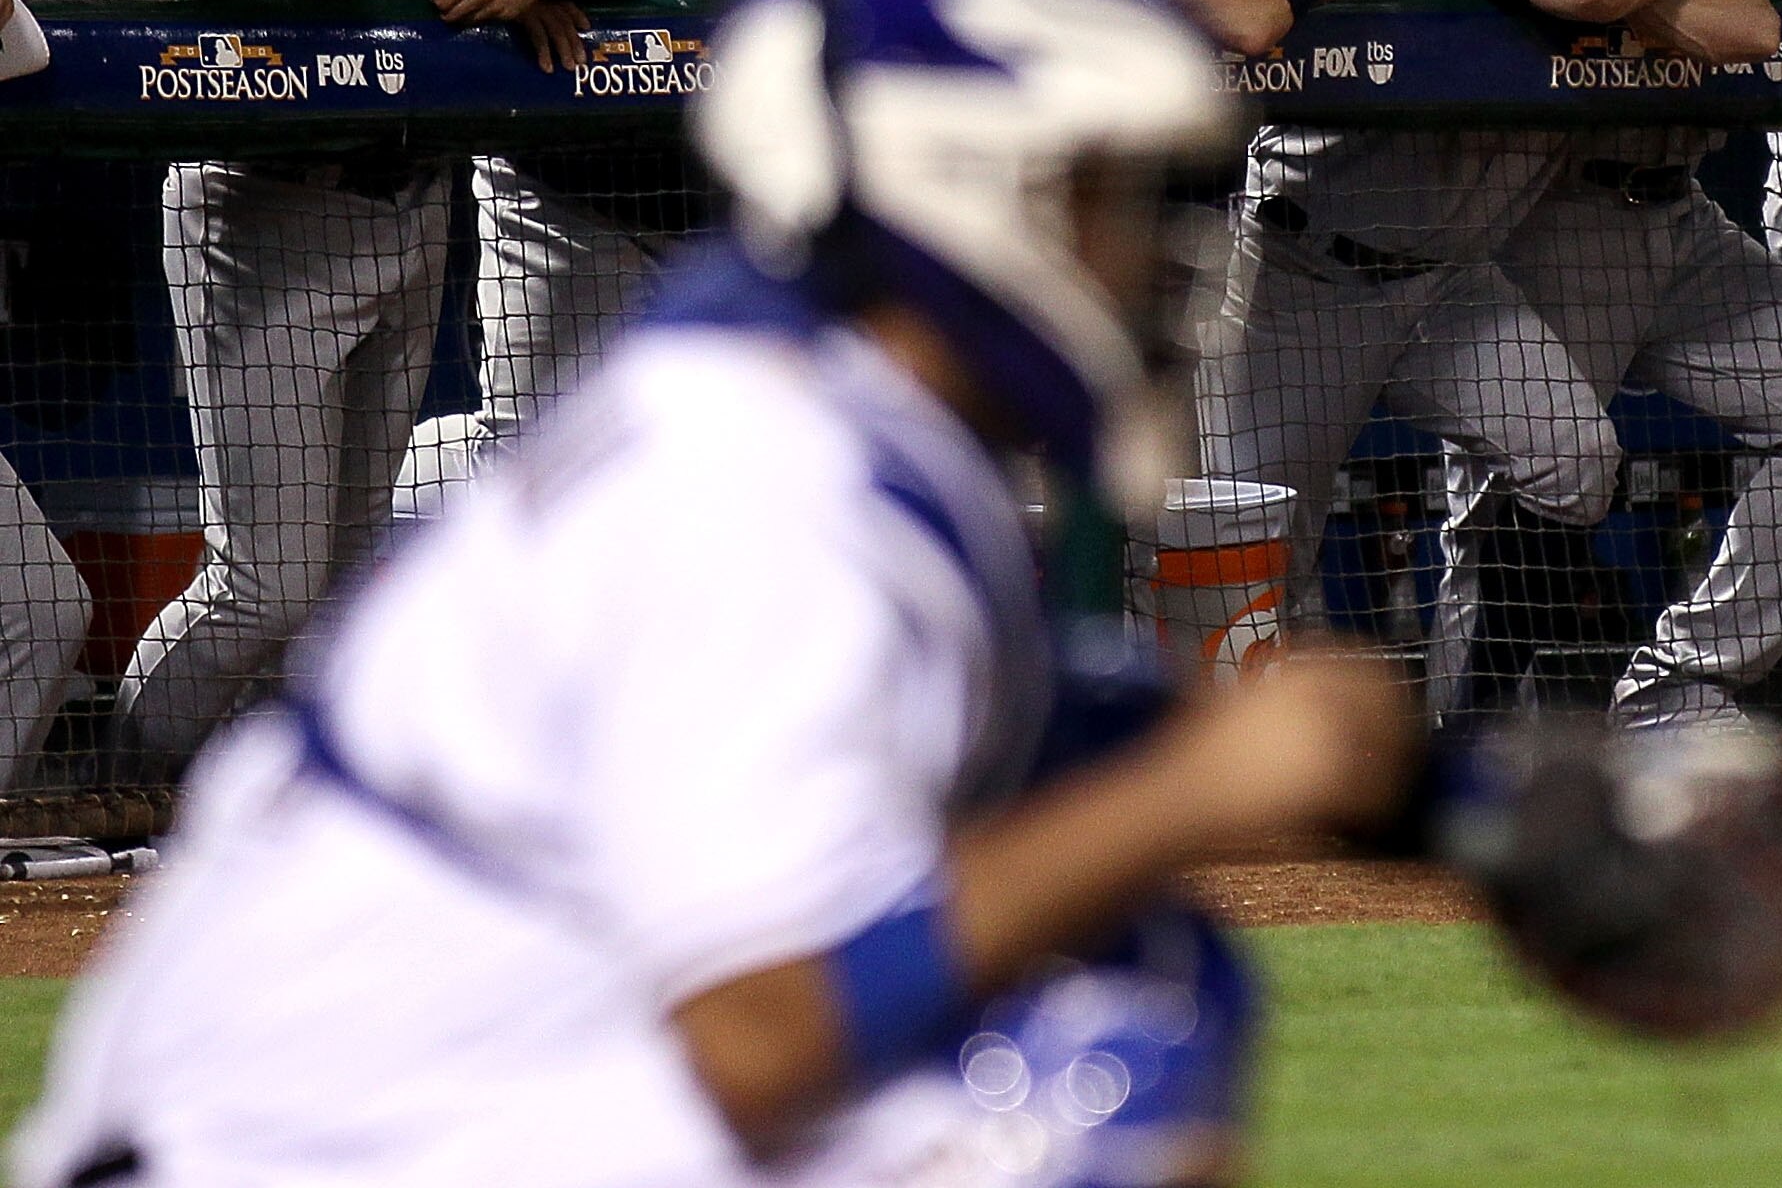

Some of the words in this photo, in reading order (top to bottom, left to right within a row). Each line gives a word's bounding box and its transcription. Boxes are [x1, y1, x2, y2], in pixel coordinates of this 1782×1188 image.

[139, 65, 308, 100] POSTSEASON
[317, 54, 368, 86] FOX
[375, 49, 404, 70] tbs
[1313, 46, 1358, 78] FOX
[1367, 41, 1394, 62] tbs
[1550, 55, 1702, 89] POSTSEASON
[574, 62, 716, 98] POSTSEASO
